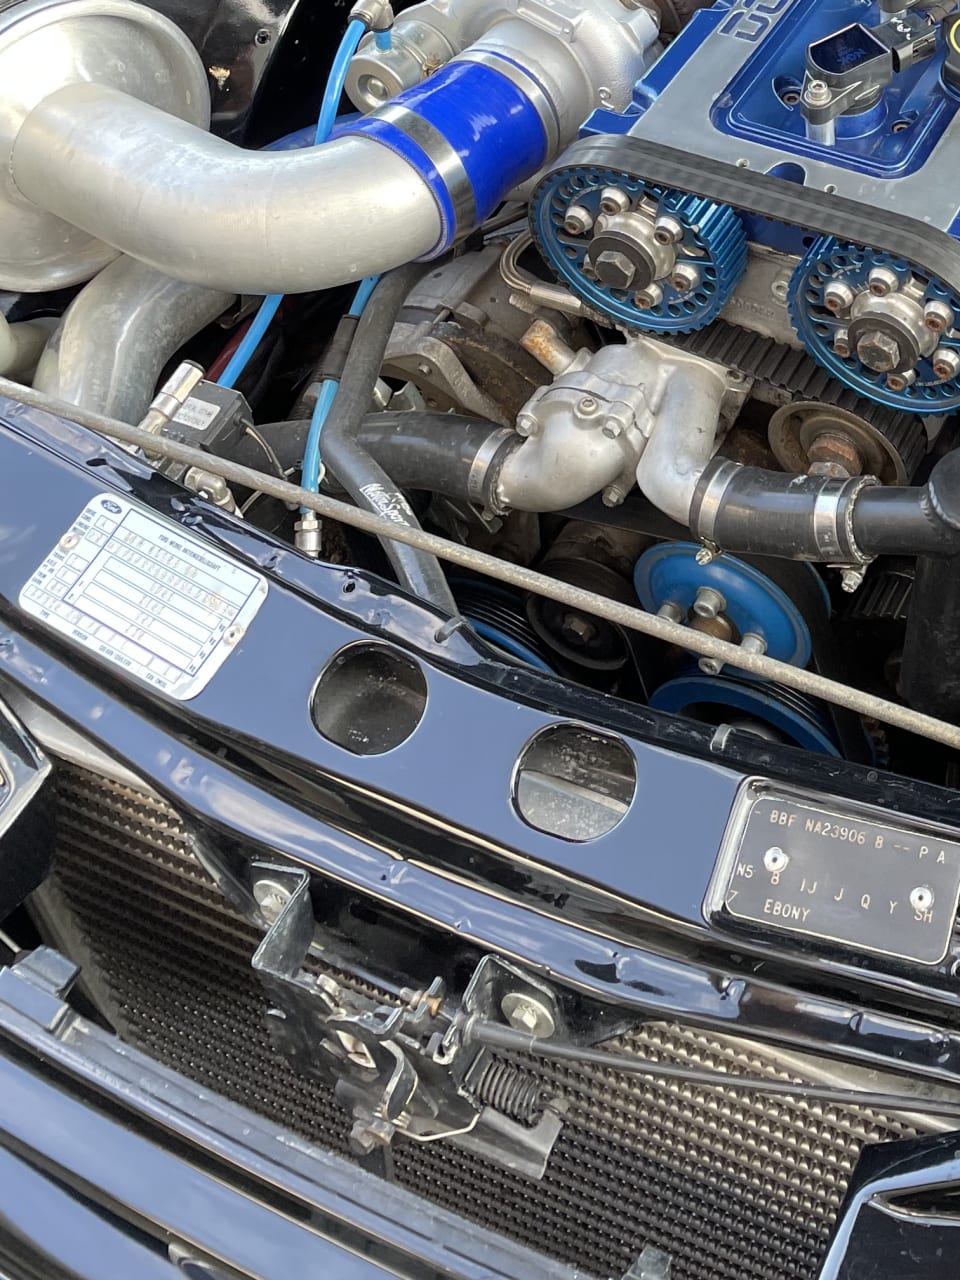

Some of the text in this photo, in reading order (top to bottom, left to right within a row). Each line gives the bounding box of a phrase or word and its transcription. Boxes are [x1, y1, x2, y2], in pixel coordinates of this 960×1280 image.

[770, 810, 797, 827] BBF
[805, 818, 866, 845] NA23906
[919, 846, 928, 859] P
[936, 850, 946, 864] A
[764, 898, 811, 922] EBONY
